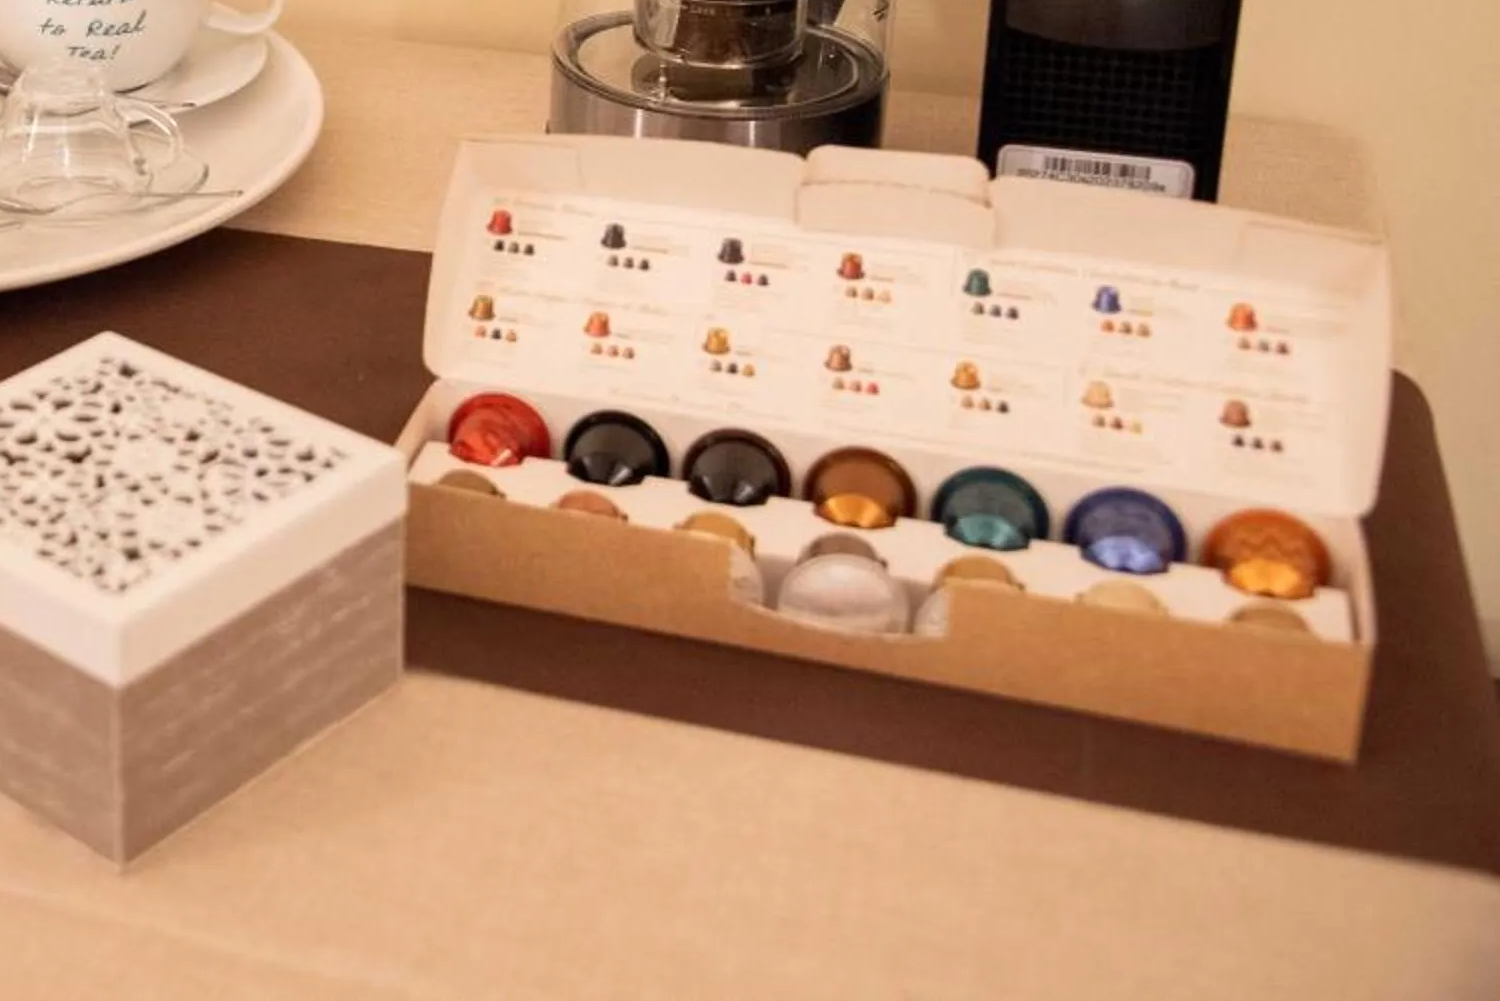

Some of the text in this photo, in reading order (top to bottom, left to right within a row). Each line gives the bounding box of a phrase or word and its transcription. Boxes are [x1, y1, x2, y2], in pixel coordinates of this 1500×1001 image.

[38, 8, 146, 37] to Real
[67, 43, 122, 61] Tea!
